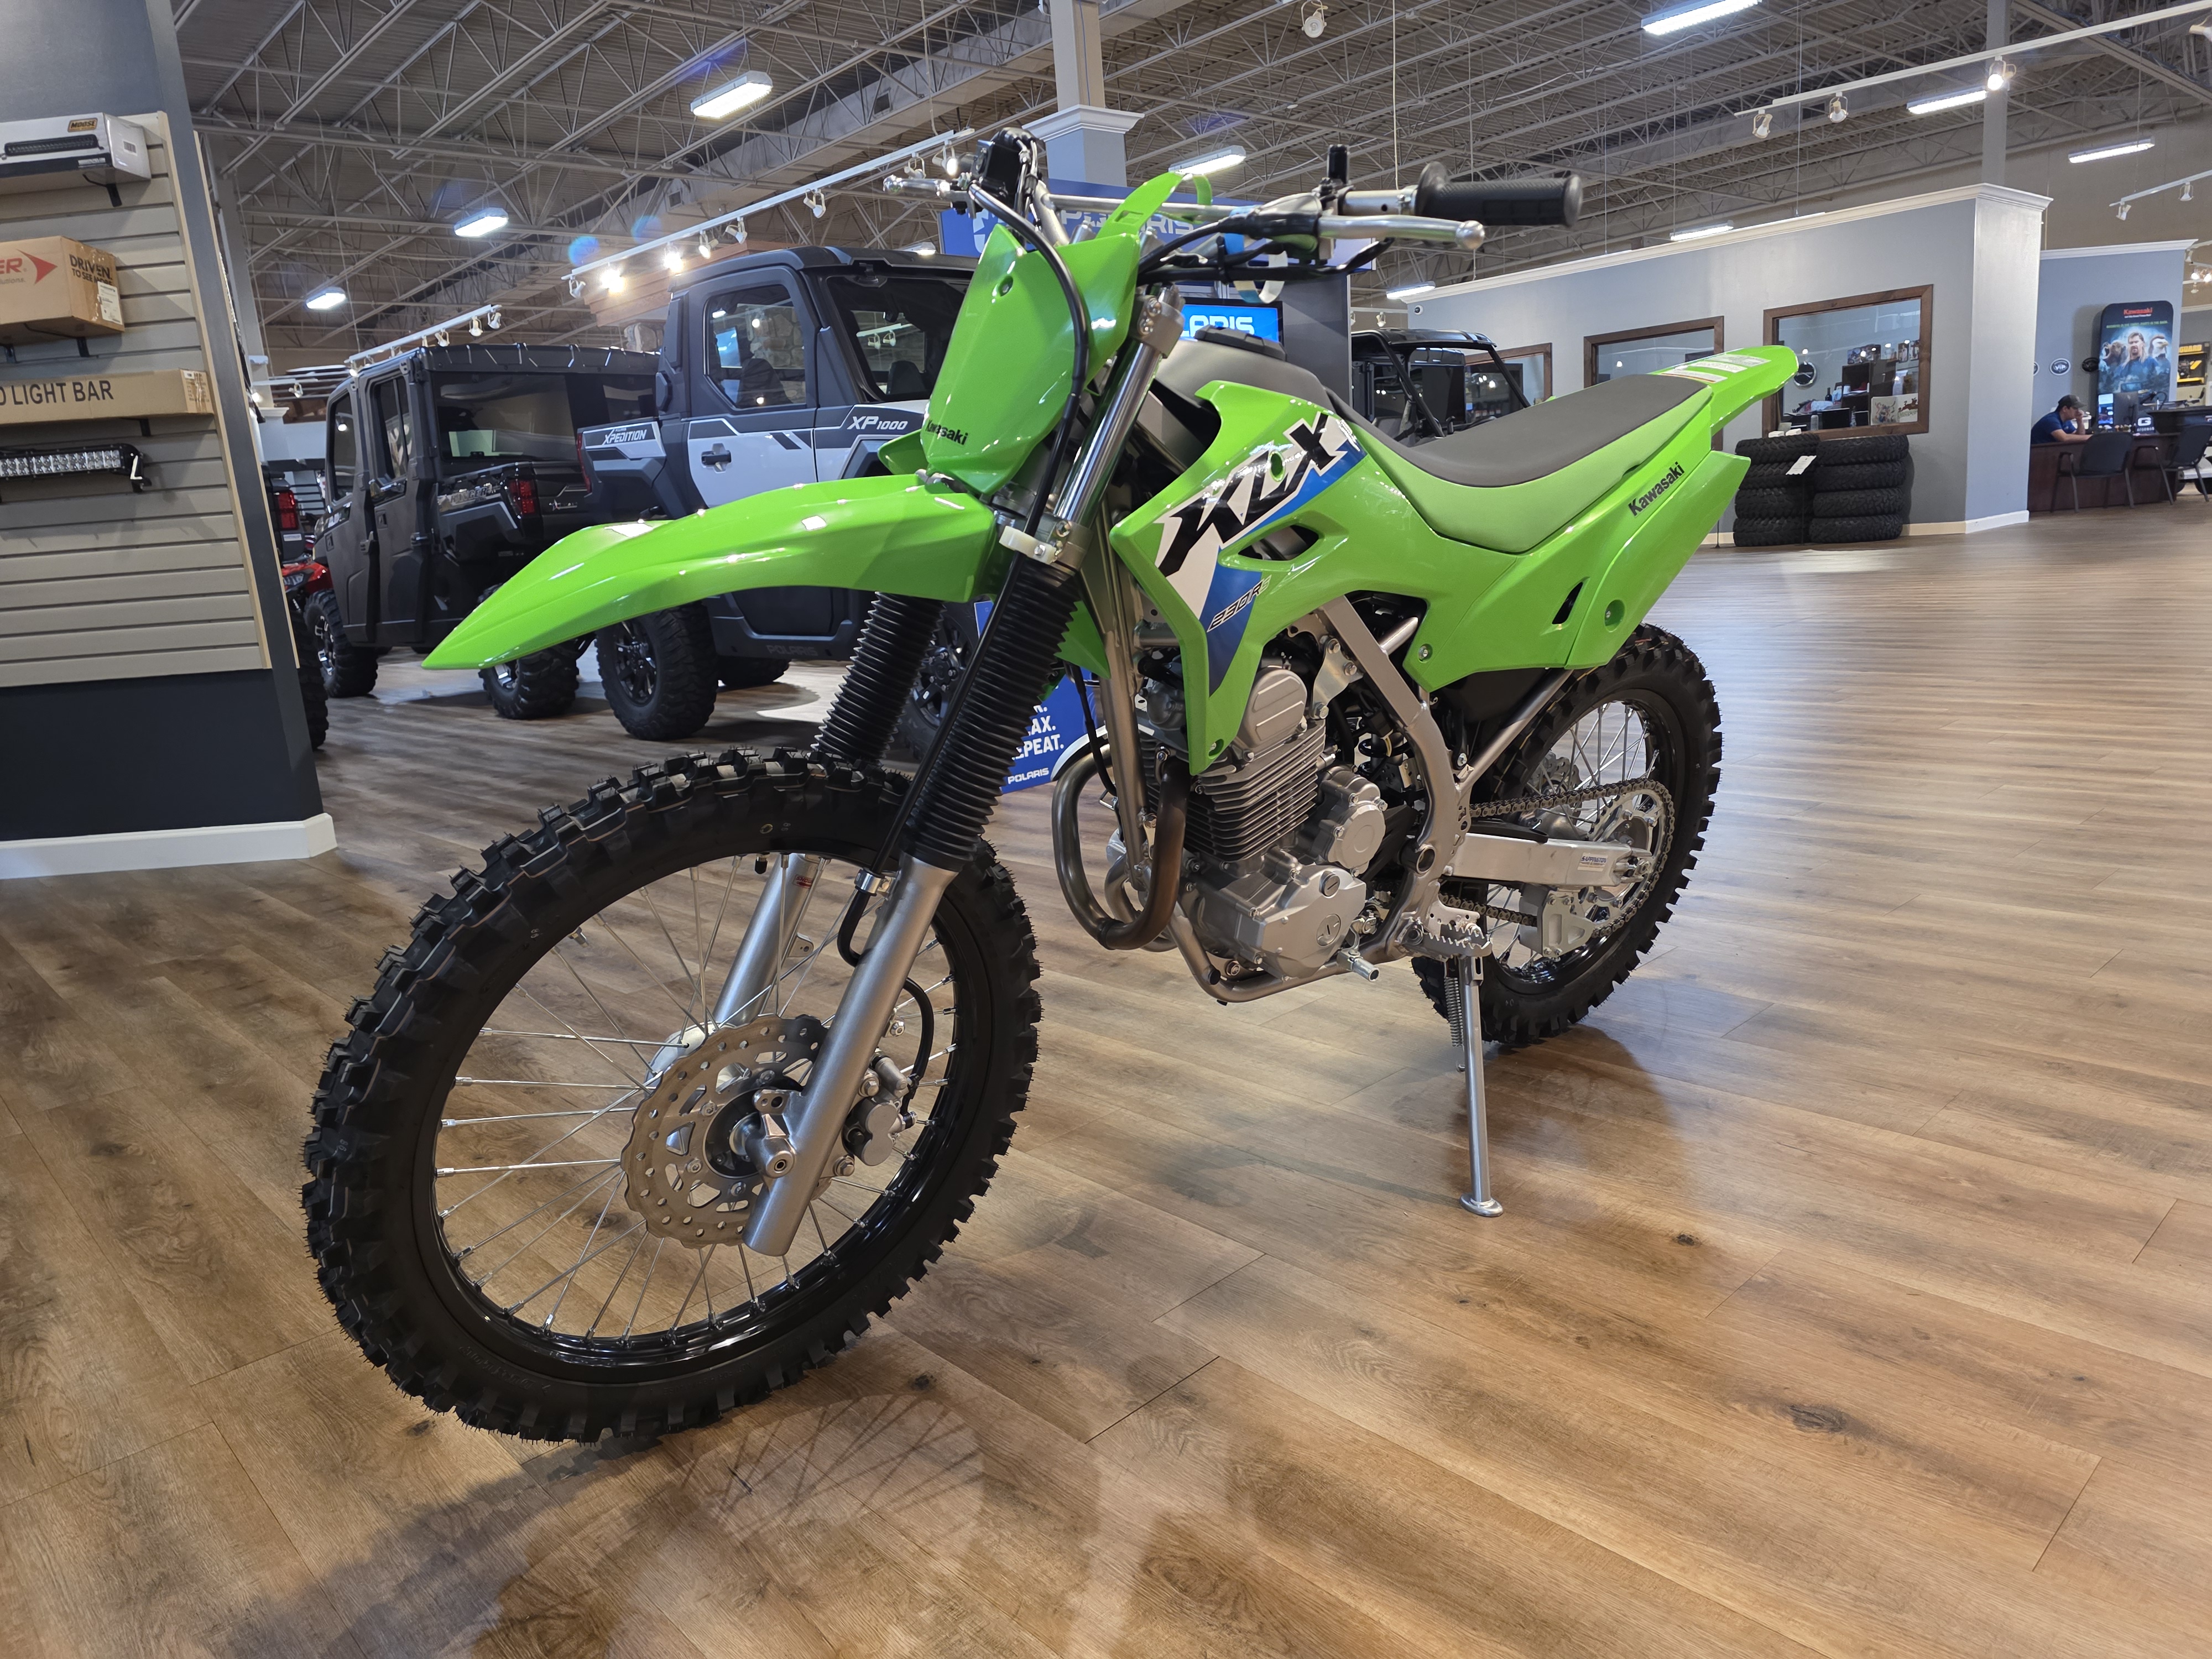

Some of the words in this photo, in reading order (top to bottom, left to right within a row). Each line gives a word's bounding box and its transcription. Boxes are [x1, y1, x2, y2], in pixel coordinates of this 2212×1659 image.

[71, 120, 96, 128] MOOSE
[71, 268, 81, 278] TO
[82, 272, 93, 283] SEE
[11, 382, 66, 405] LIGHT
[72, 380, 114, 402] BAR
[847, 416, 879, 430] XP
[877, 421, 909, 430] 1000
[925, 419, 968, 445] Kawasaki
[602, 429, 647, 446] XPEDITION
[1158, 413, 1338, 578] KLX
[1628, 461, 1685, 517] Kawasaki
[1027, 715, 1057, 736] AX.
[1011, 734, 1065, 761] EPEAT.
[1008, 768, 1050, 784] POLARIS
